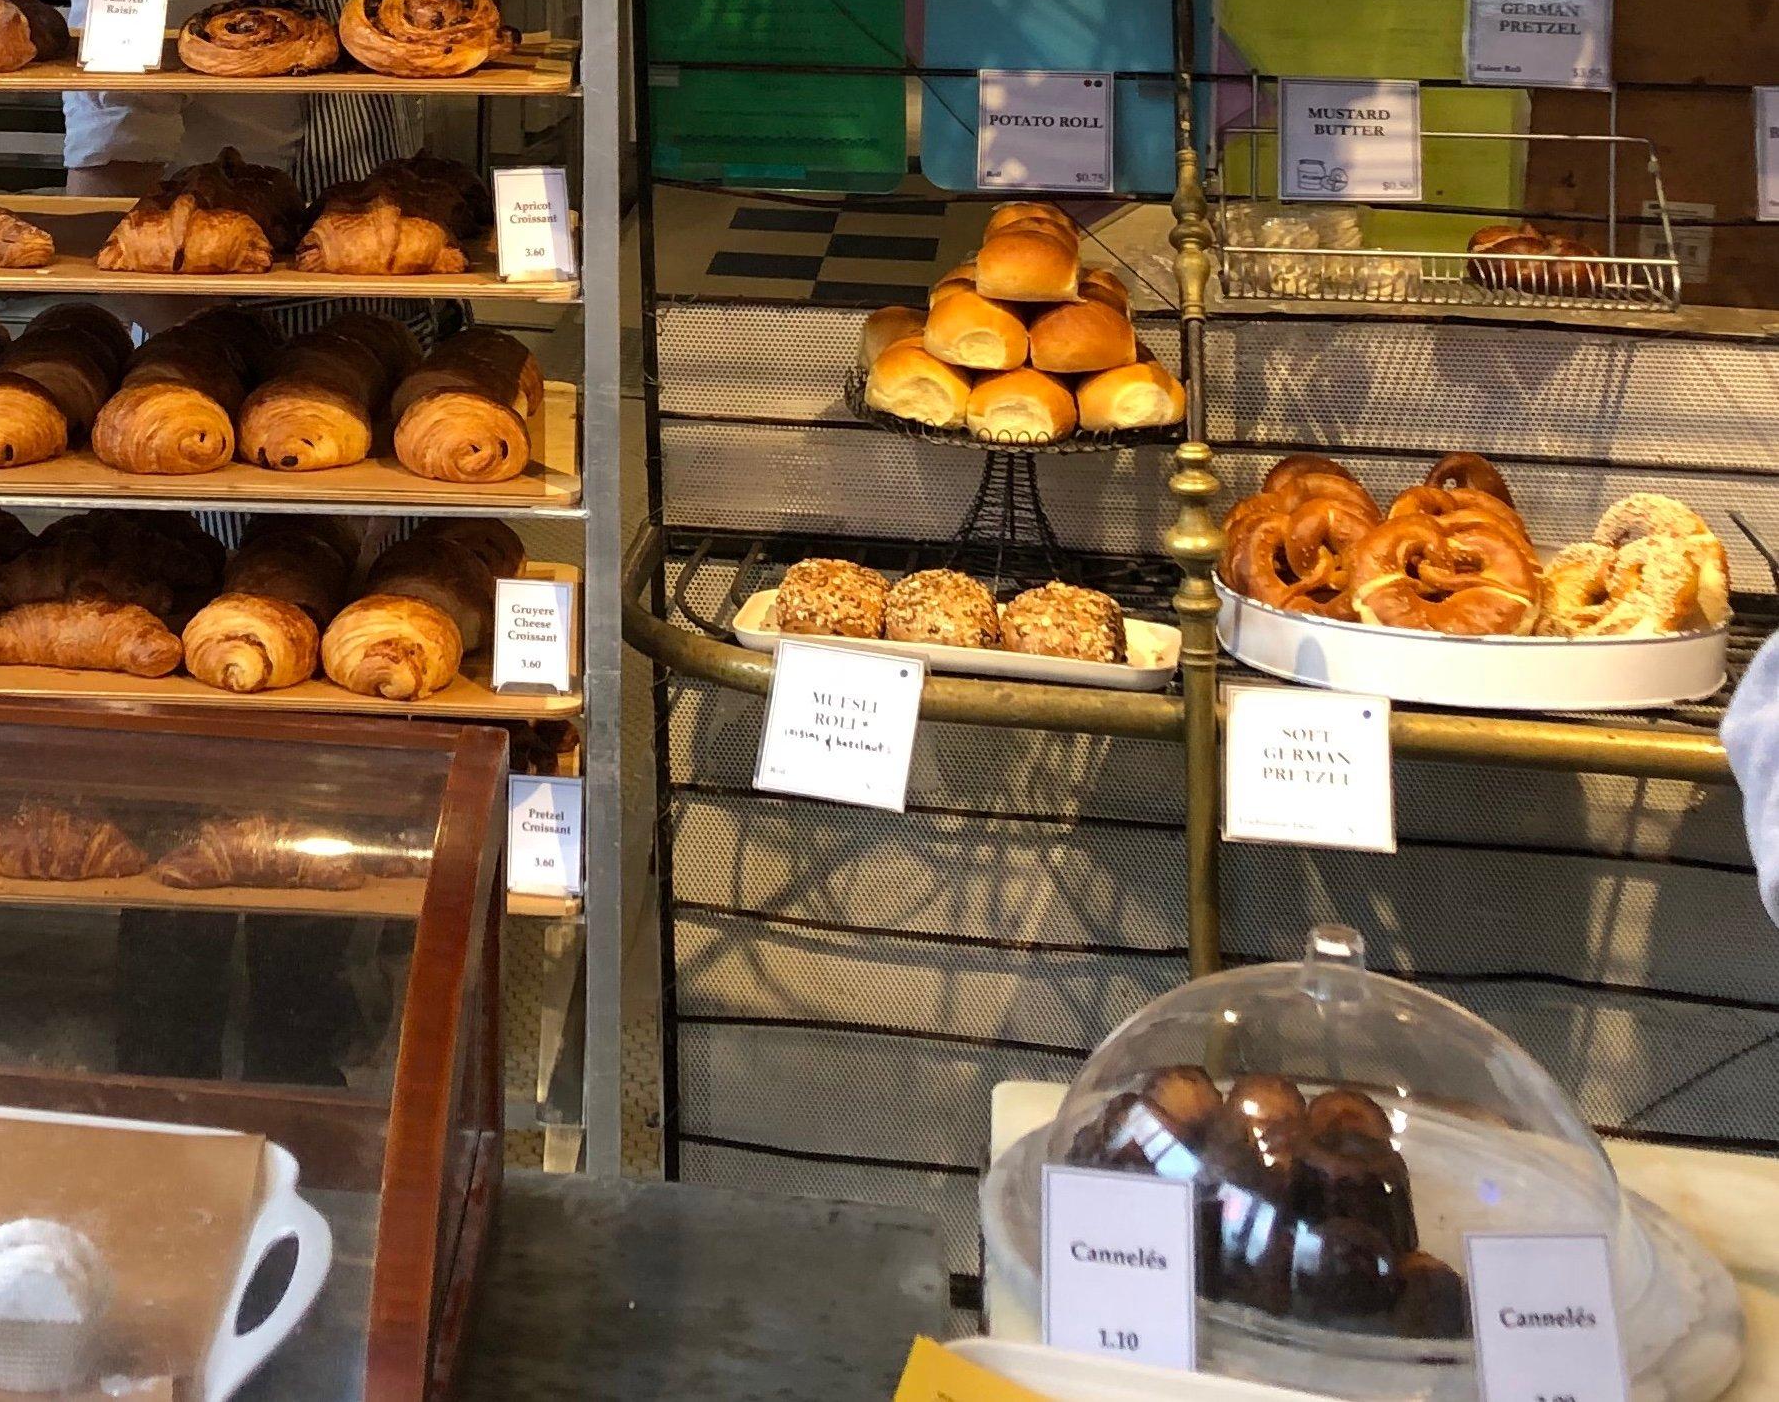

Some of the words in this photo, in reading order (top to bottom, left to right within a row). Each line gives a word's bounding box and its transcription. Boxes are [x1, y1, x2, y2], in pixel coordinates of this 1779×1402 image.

[107, 5, 138, 15] Raisin
[1501, 2, 1581, 17] GERMAN
[1499, 19, 1581, 35] PRETZEL
[1308, 107, 1391, 121] MUSTARD
[989, 114, 1055, 127] POTATO
[1060, 116, 1103, 129] ROLL
[1314, 124, 1385, 136] BUTTER
[514, 201, 551, 213] Apricot
[509, 214, 557, 224] Croissant
[525, 248, 545, 258] 3.60
[511, 604, 555, 617] Gruyere
[514, 618, 551, 629] Cheese
[507, 630, 557, 643] Croissant
[521, 659, 542, 669] 3.60
[528, 807, 565, 821] Pretzel
[521, 821, 571, 835] Croissant
[533, 857, 554, 868] 3.60
[1069, 1239, 1167, 1270] Cannelés
[1499, 1305, 1597, 1329] Cannelés
[1098, 1327, 1140, 1352] 1.10
